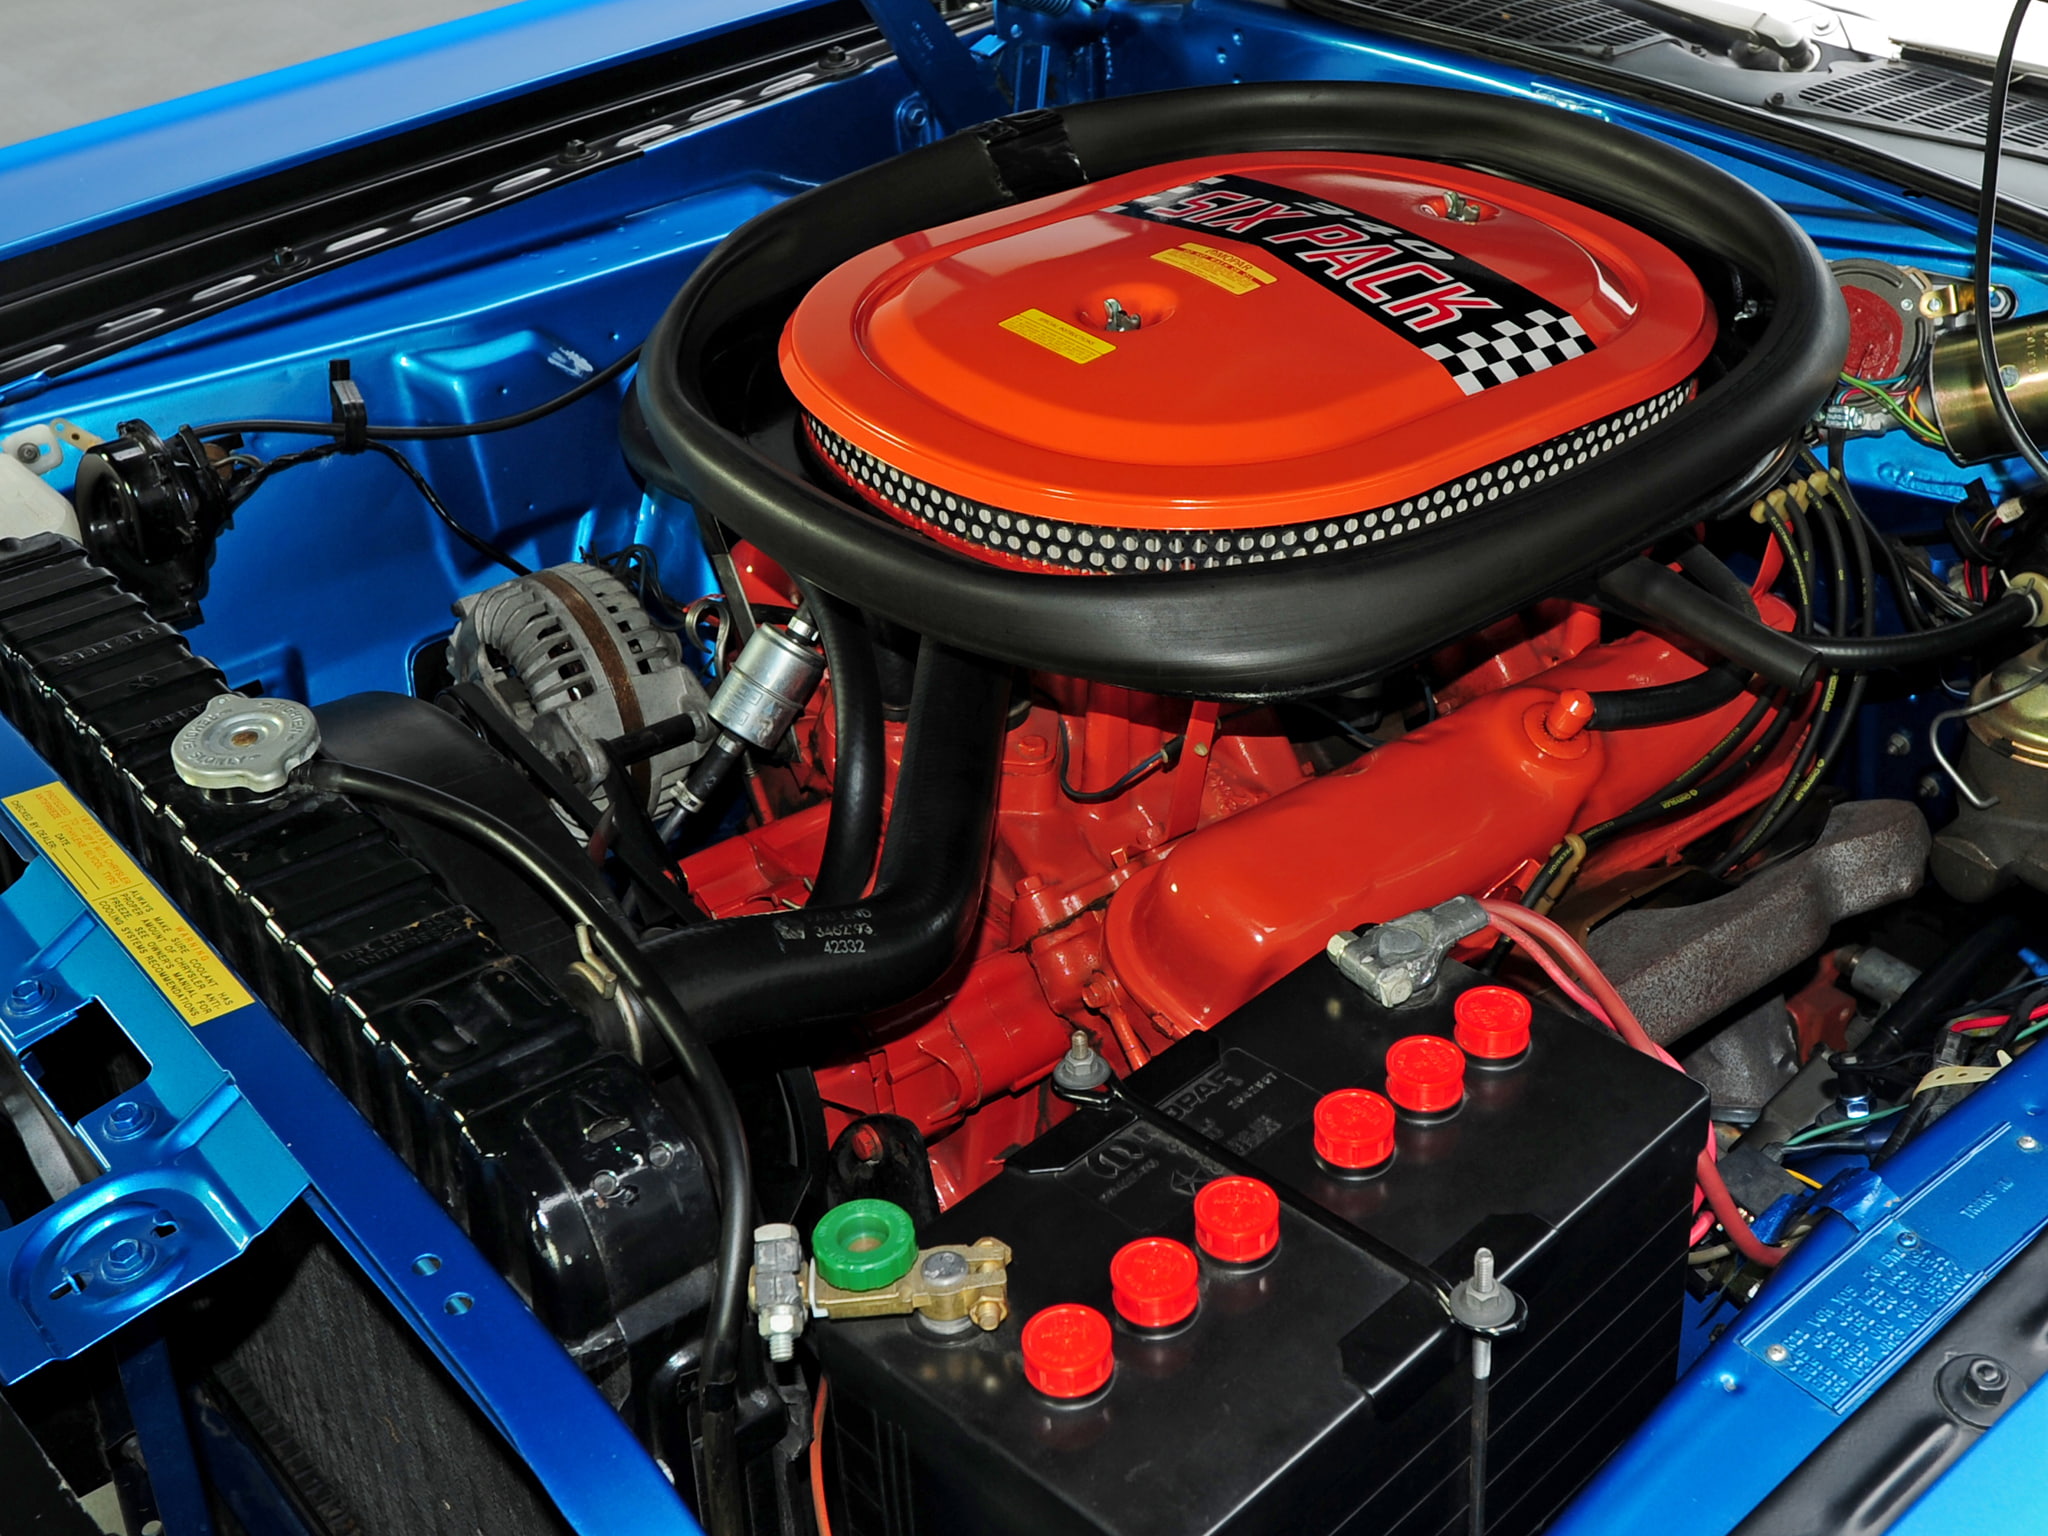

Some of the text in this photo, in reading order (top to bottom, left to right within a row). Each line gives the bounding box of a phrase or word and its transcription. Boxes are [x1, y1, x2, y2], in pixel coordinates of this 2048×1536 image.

[1290, 199, 1456, 261] 340
[1145, 189, 1318, 234] SIX
[1261, 223, 1503, 333] PACK
[188, 752, 246, 767] SLOWLY
[10, 799, 33, 821] CHECKED
[29, 821, 39, 829] BY
[54, 832, 70, 847] DATE
[98, 899, 124, 926] COOLING
[120, 925, 148, 954] SYSTEMS
[119, 892, 223, 1010] PROPER AMOUNT OF CHRYSLER ANTI-
[129, 889, 234, 1006] ALWAYS MAKE SURE COOLANT HAS
[174, 925, 211, 962] WARNING
[823, 939, 867, 954] 42332
[134, 925, 149, 939] SEE
[146, 940, 175, 969] OWNER'S
[172, 970, 199, 998] MANUAL
[196, 999, 213, 1014] FOR
